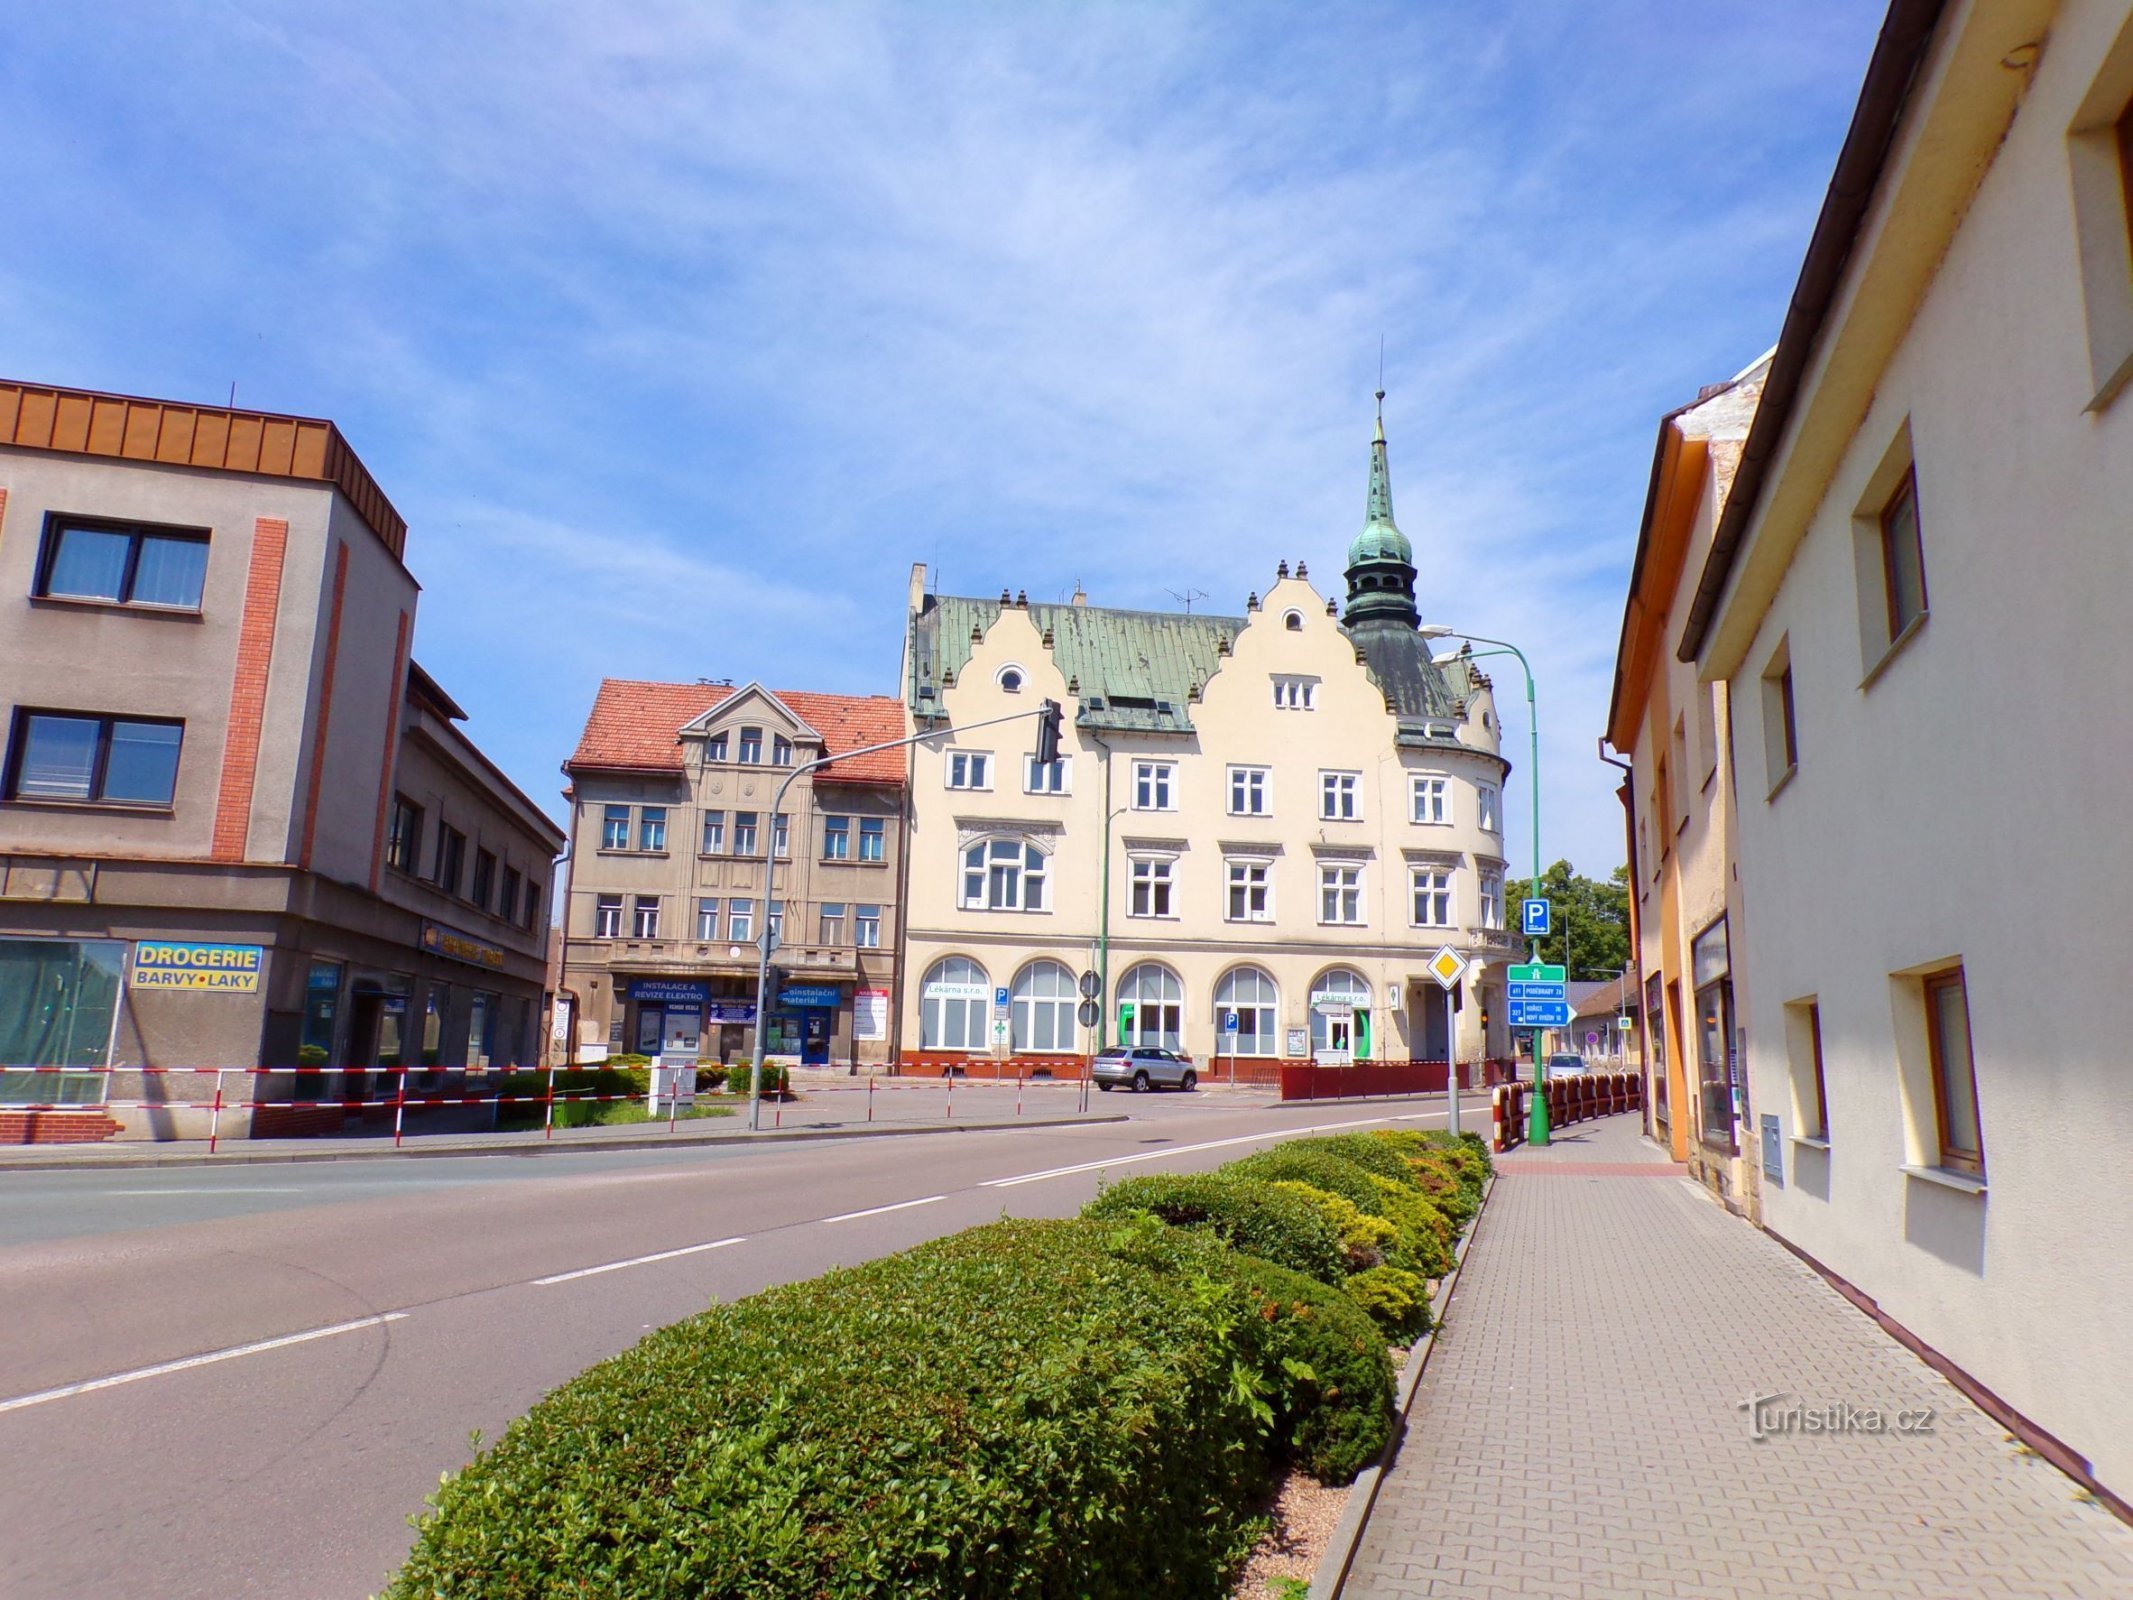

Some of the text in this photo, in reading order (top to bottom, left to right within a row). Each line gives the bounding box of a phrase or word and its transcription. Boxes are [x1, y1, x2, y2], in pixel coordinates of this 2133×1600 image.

[1529, 904, 1544, 924] P
[139, 946, 257, 968] DROGERIE
[136, 971, 254, 987] BARVY LAKY
[643, 982, 688, 991] INSTALACE
[929, 985, 961, 994] Lékárna
[634, 991, 703, 1000] REVIZE ELEKTRO
[783, 988, 836, 997] oinstalační
[998, 990, 1006, 1001] P
[1228, 1015, 1236, 1026] P
